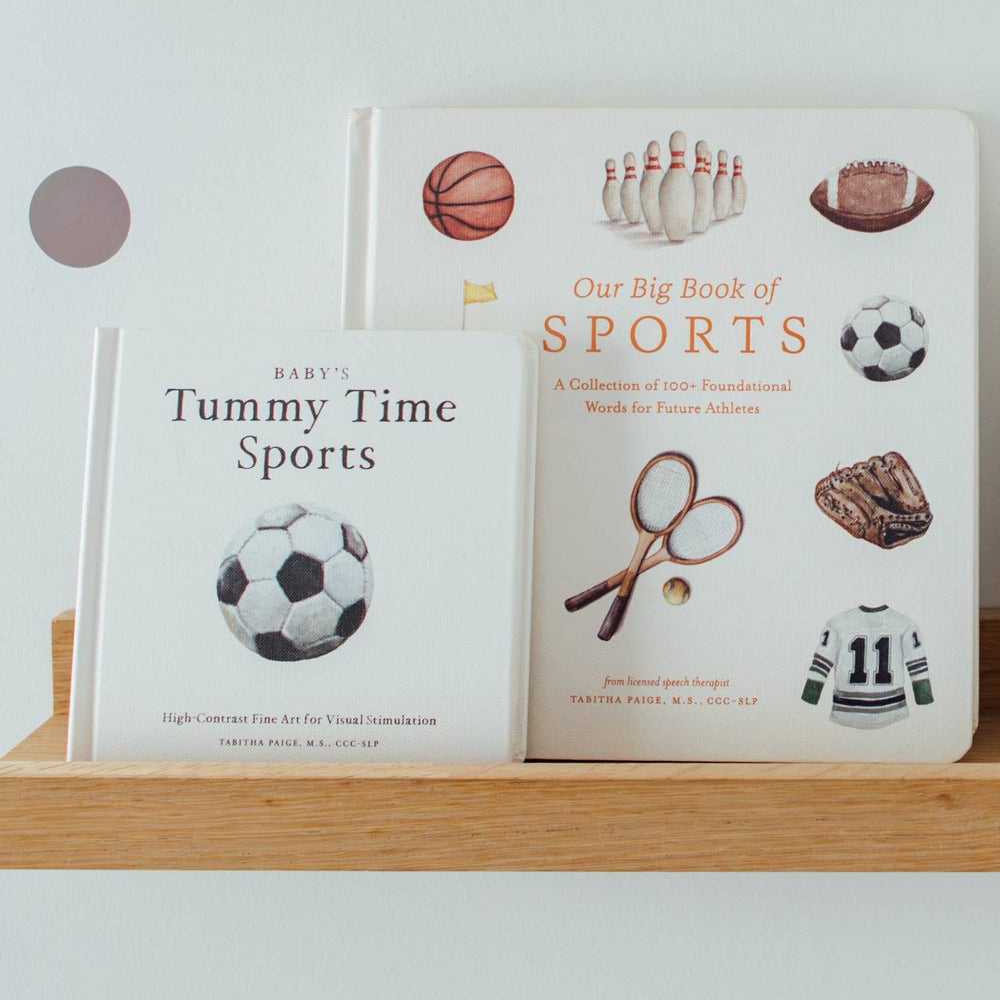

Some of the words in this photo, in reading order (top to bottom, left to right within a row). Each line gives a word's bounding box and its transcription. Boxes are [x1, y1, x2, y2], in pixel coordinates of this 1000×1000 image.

[573, 277, 624, 299] Our
[631, 277, 673, 305] Big
[680, 277, 746, 299] Book
[754, 277, 782, 306] of
[543, 315, 806, 354] SPORTS
[274, 367, 350, 380] BABY'S
[553, 378, 565, 391] A
[569, 378, 641, 391] Collection
[645, 378, 661, 391] of
[663, 380, 697, 391] 100+
[701, 379, 792, 392] Foundational
[165, 388, 329, 435] Tummy
[345, 389, 457, 423] Time
[585, 400, 627, 414] Words
[632, 401, 652, 414] for
[657, 401, 701, 414] Future
[705, 401, 760, 414] Athletes
[237, 435, 375, 480] Sports
[848, 635, 893, 686] 11
[603, 675, 624, 689] from
[627, 675, 661, 687] licensed
[662, 676, 689, 690] speech
[692, 676, 730, 690] therapist
[570, 695, 622, 704] TABITHA
[627, 696, 666, 705] PAIGE,
[672, 696, 702, 706] M.S.,
[707, 697, 759, 706] CCC-SLP
[163, 712, 248, 726] High-Contrast
[252, 714, 278, 724] Fine
[281, 714, 300, 724] Art
[304, 713, 322, 724] for
[327, 714, 363, 725] Visual
[366, 715, 437, 725] Stimulation
[220, 738, 264, 746] TABITHA
[335, 740, 379, 748] CCC-SLP
